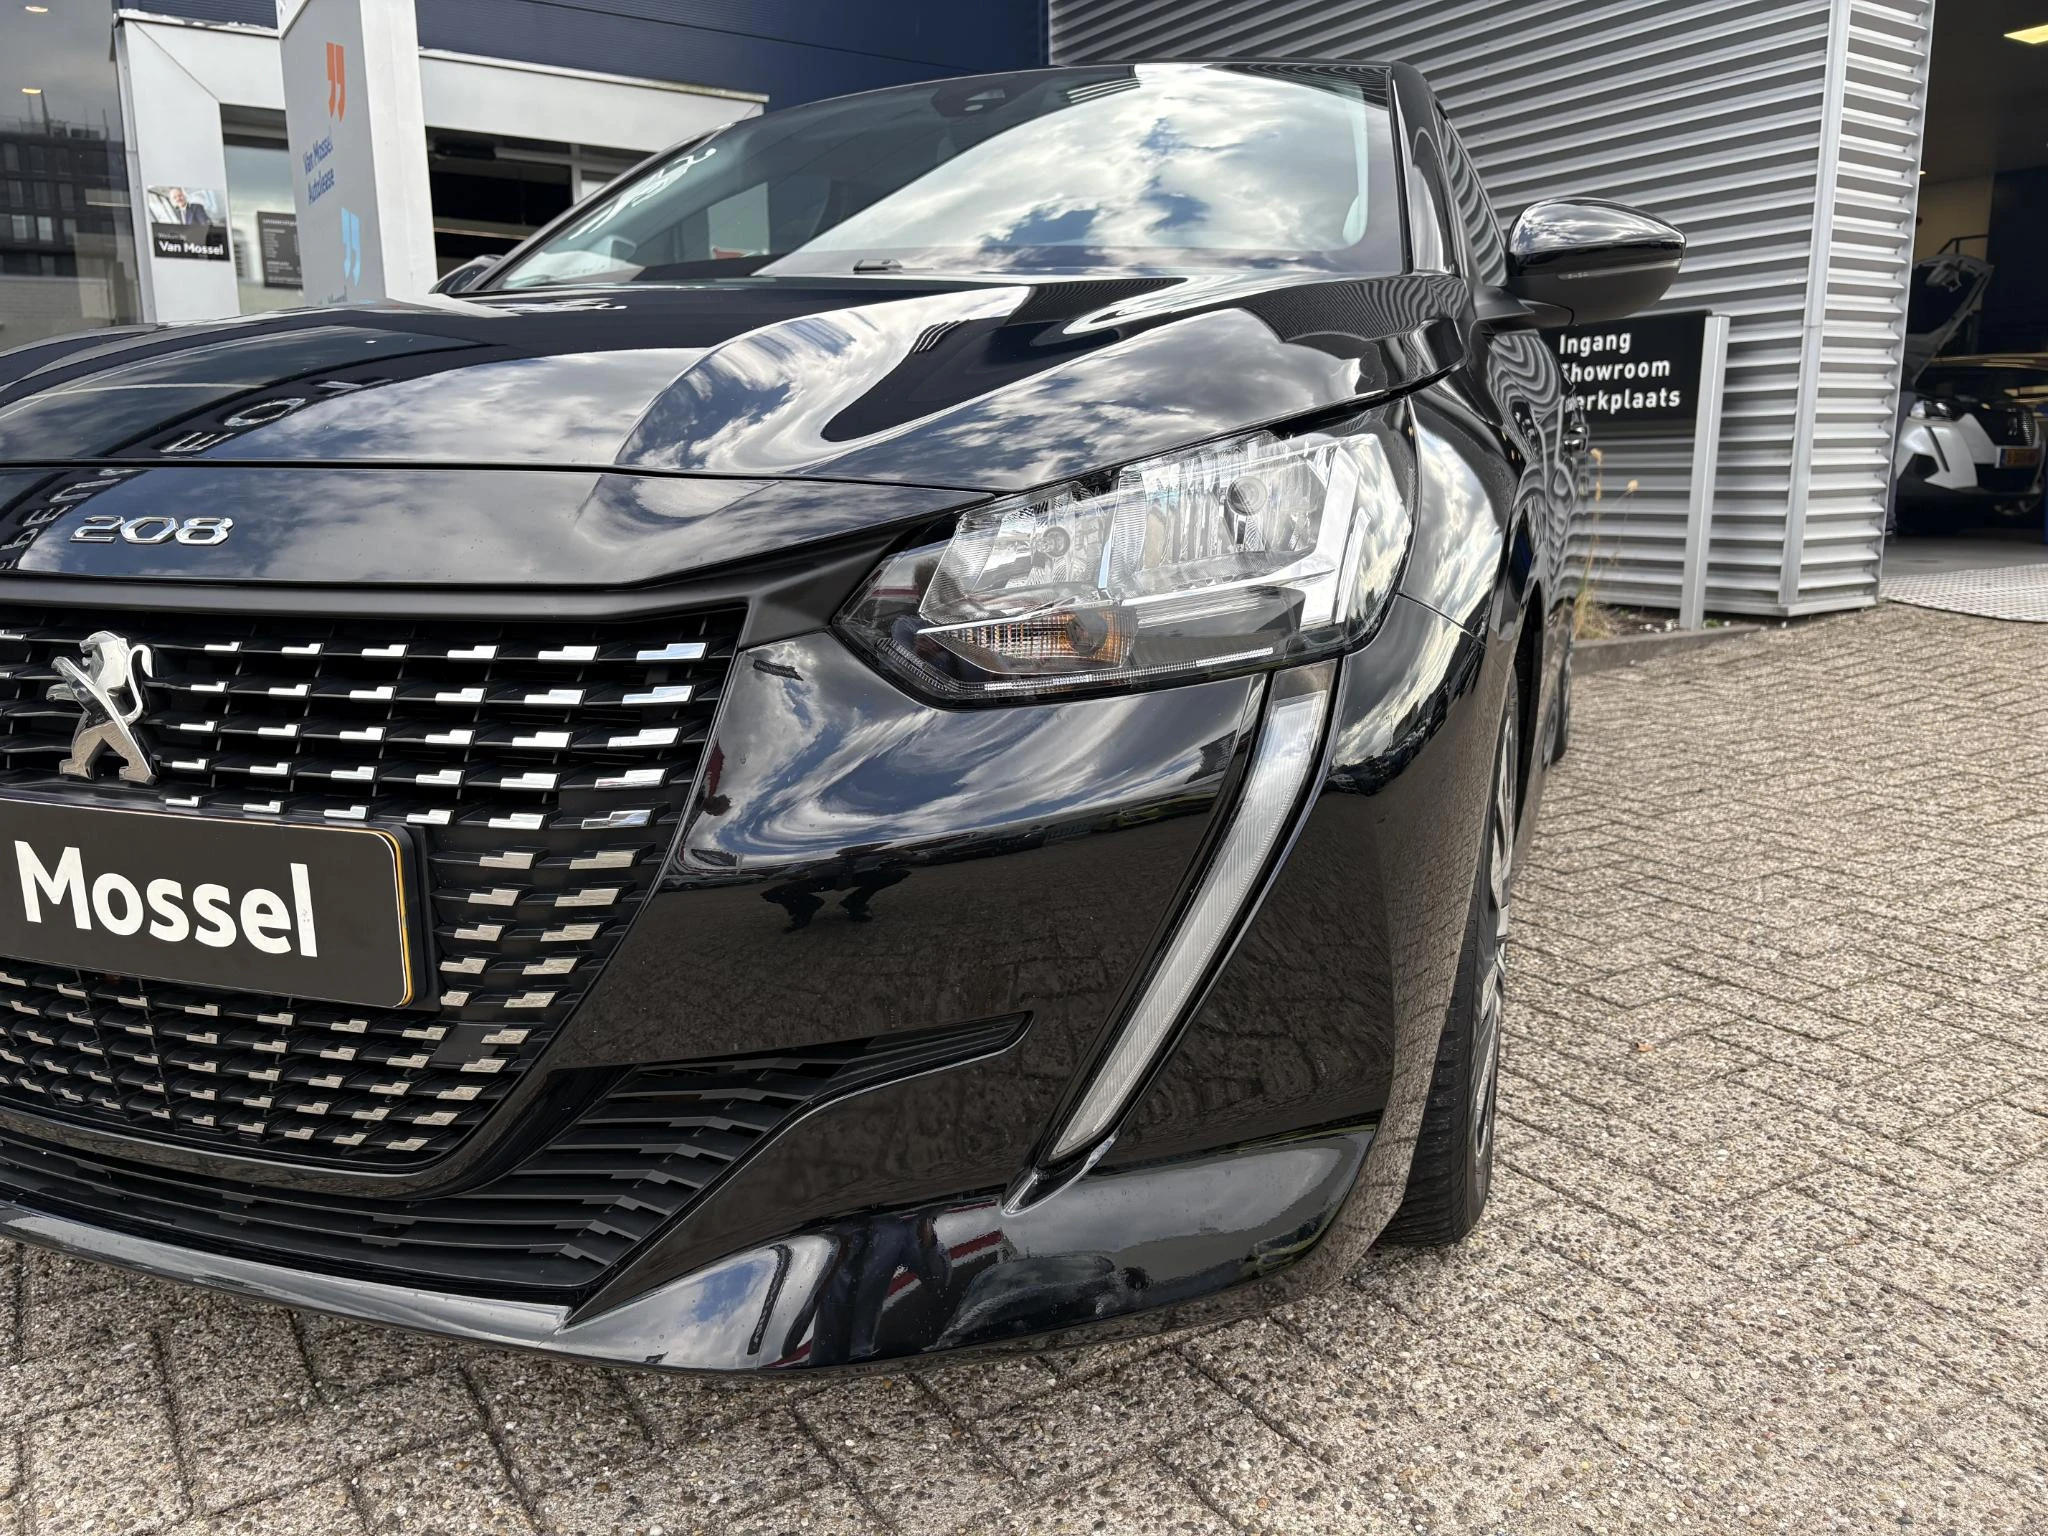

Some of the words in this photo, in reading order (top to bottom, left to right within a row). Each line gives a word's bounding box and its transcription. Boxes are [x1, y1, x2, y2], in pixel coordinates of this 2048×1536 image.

[159, 241, 181, 252] Van
[183, 242, 224, 256] Mossel
[1559, 332, 1631, 357] Ingang
[1565, 387, 1681, 415] erkplaats
[69, 515, 235, 546] 208
[14, 840, 318, 958] Mossel
